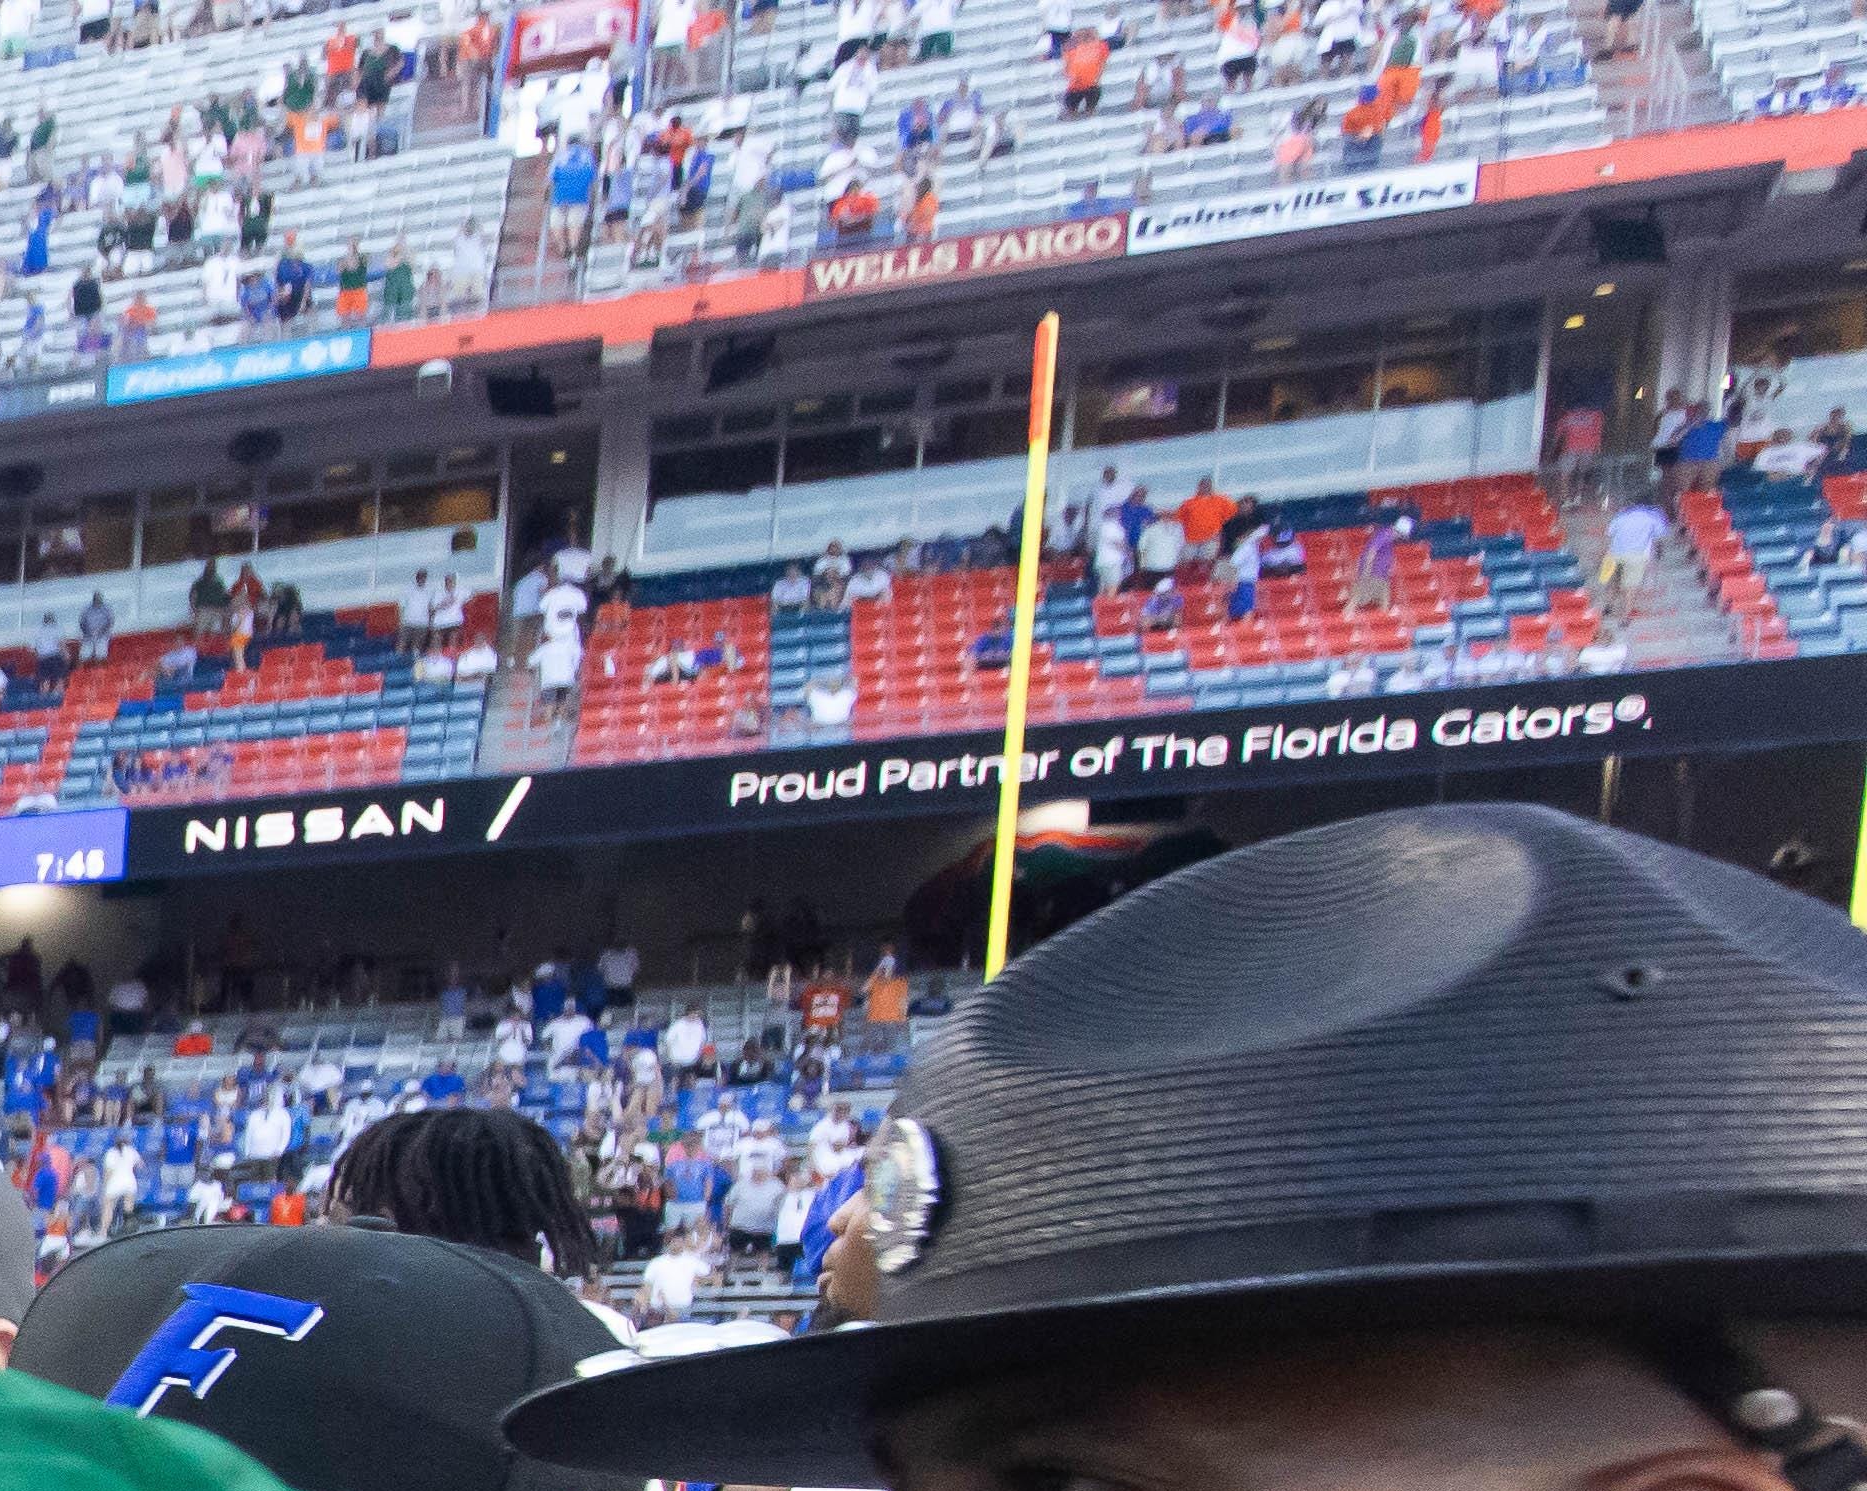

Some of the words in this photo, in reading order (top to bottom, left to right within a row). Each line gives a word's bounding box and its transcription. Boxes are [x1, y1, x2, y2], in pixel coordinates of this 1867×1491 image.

[811, 241, 959, 293] WELLS
[970, 216, 1121, 270] FARGO
[729, 760, 868, 807] Proud
[1070, 735, 1125, 779] of
[1131, 732, 1230, 772] The
[1240, 713, 1419, 764] Florida
[184, 796, 446, 855] NISSAN
[105, 1281, 325, 1419] F
